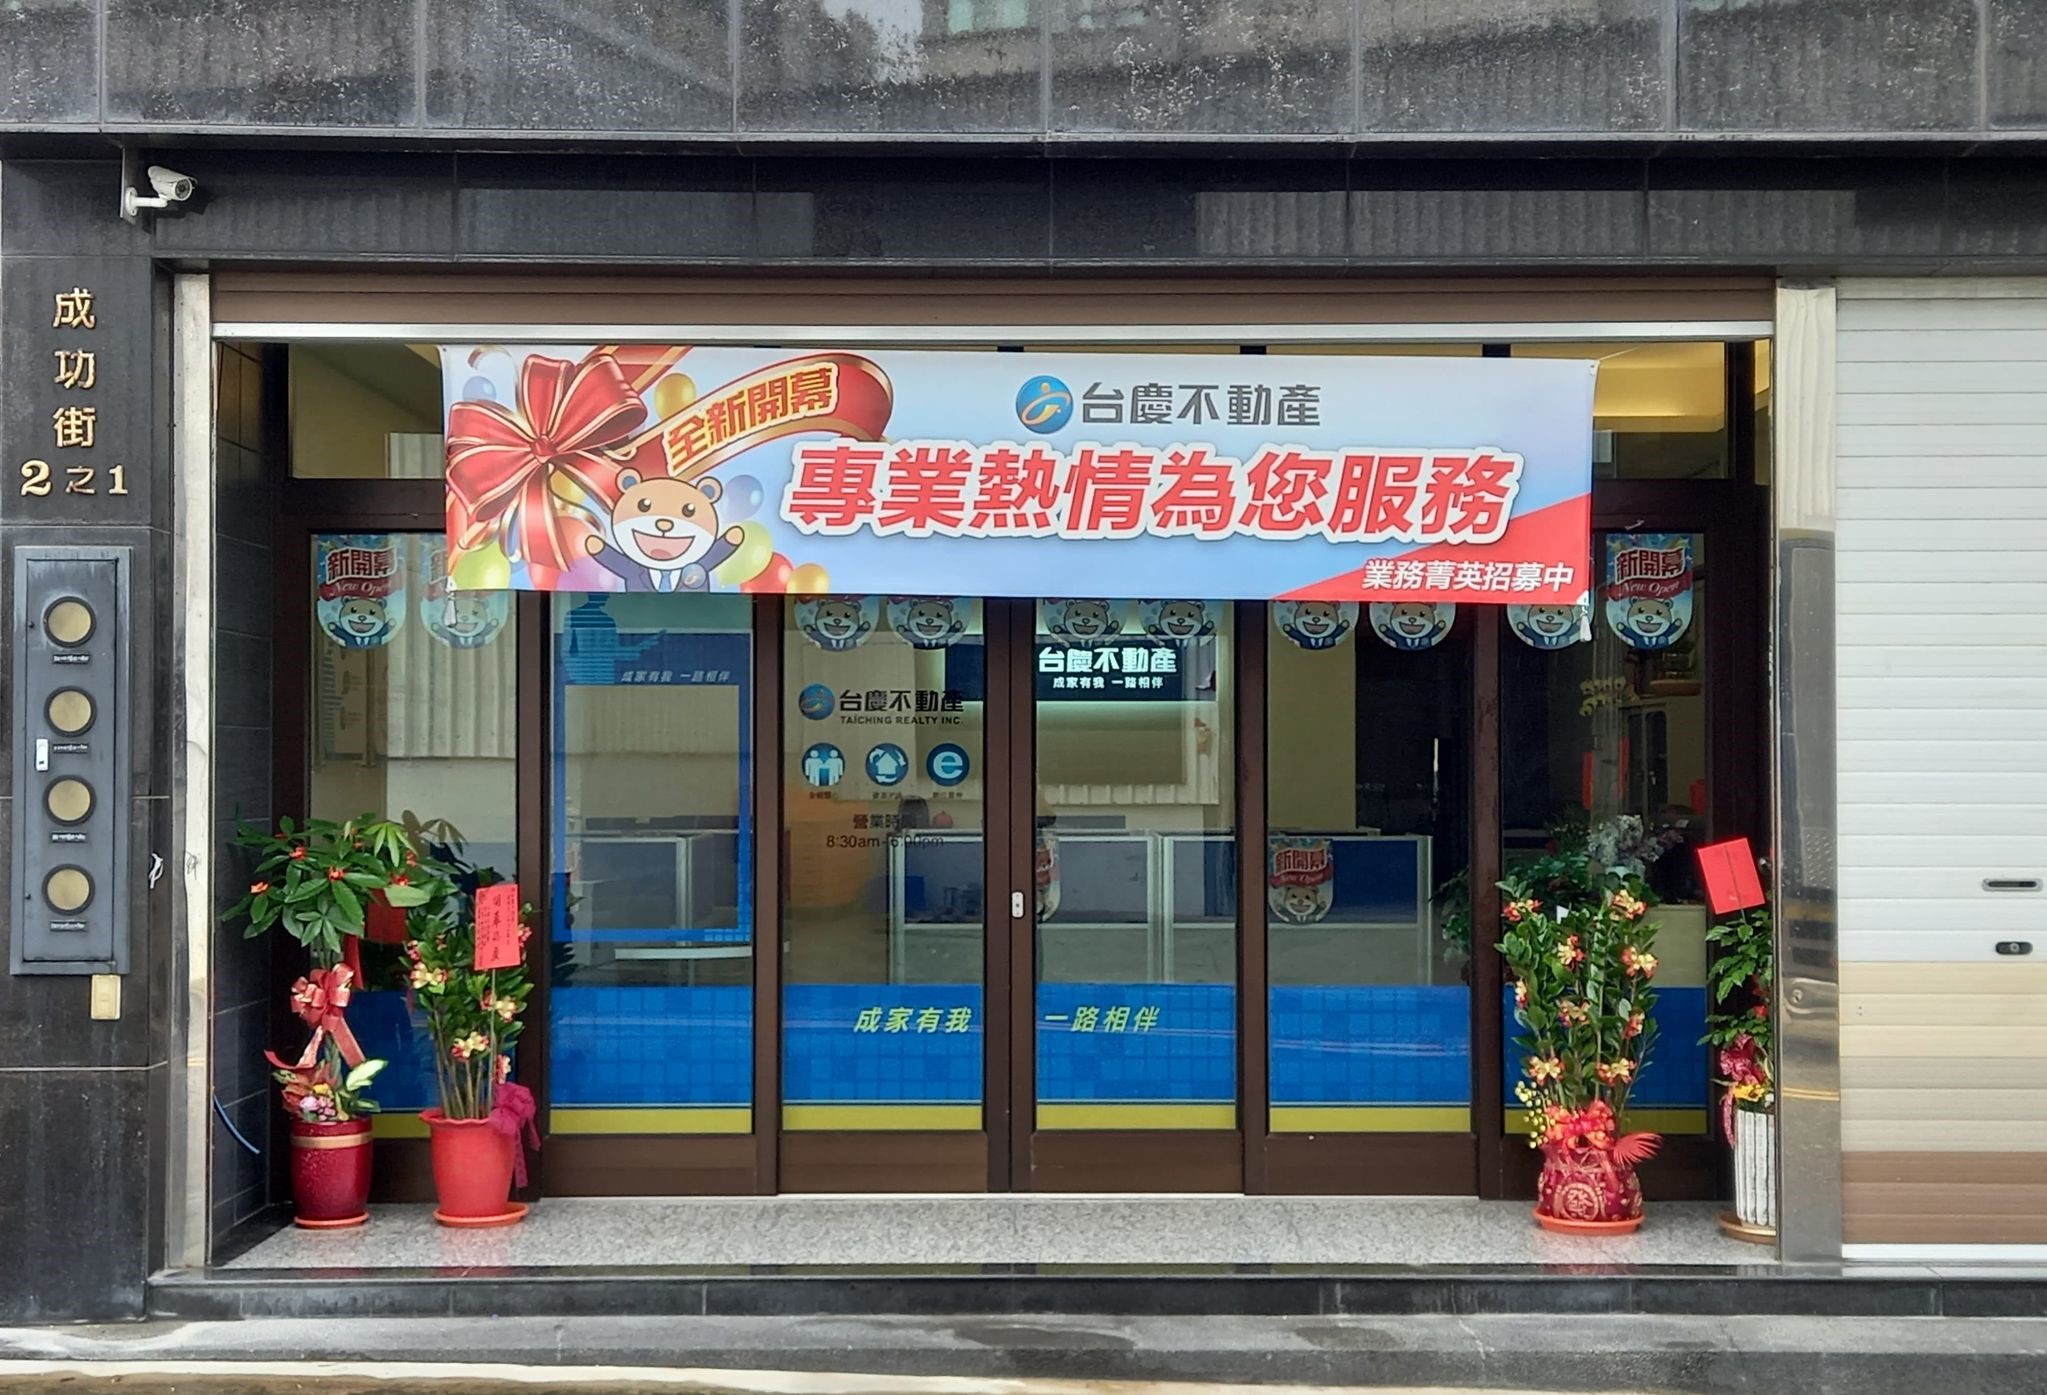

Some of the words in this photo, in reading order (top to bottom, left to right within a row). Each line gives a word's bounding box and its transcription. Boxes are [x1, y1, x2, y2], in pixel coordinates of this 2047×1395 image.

[52, 287, 97, 448] 成功街
[667, 366, 834, 472] 全新開幕
[1082, 381, 1321, 427] 台慶不動產
[788, 445, 1515, 538] 專業熱情為您服務
[326, 547, 397, 584] 新開幕
[1361, 559, 1574, 593] 業務菁英招募中
[1615, 547, 1685, 584] 新開幕
[1622, 580, 1648, 593] New
[1648, 580, 1680, 597] Open
[1038, 647, 1177, 673] 台慶不動產
[1053, 677, 1105, 689] 成家有我
[1111, 677, 1164, 689] 一路相伴
[839, 689, 964, 712] 台慶不動產
[895, 716, 938, 725] REALTY
[941, 716, 964, 725] INC.
[853, 1006, 972, 1033] 成家有我
[1044, 1006, 1161, 1033] 一路相伴
